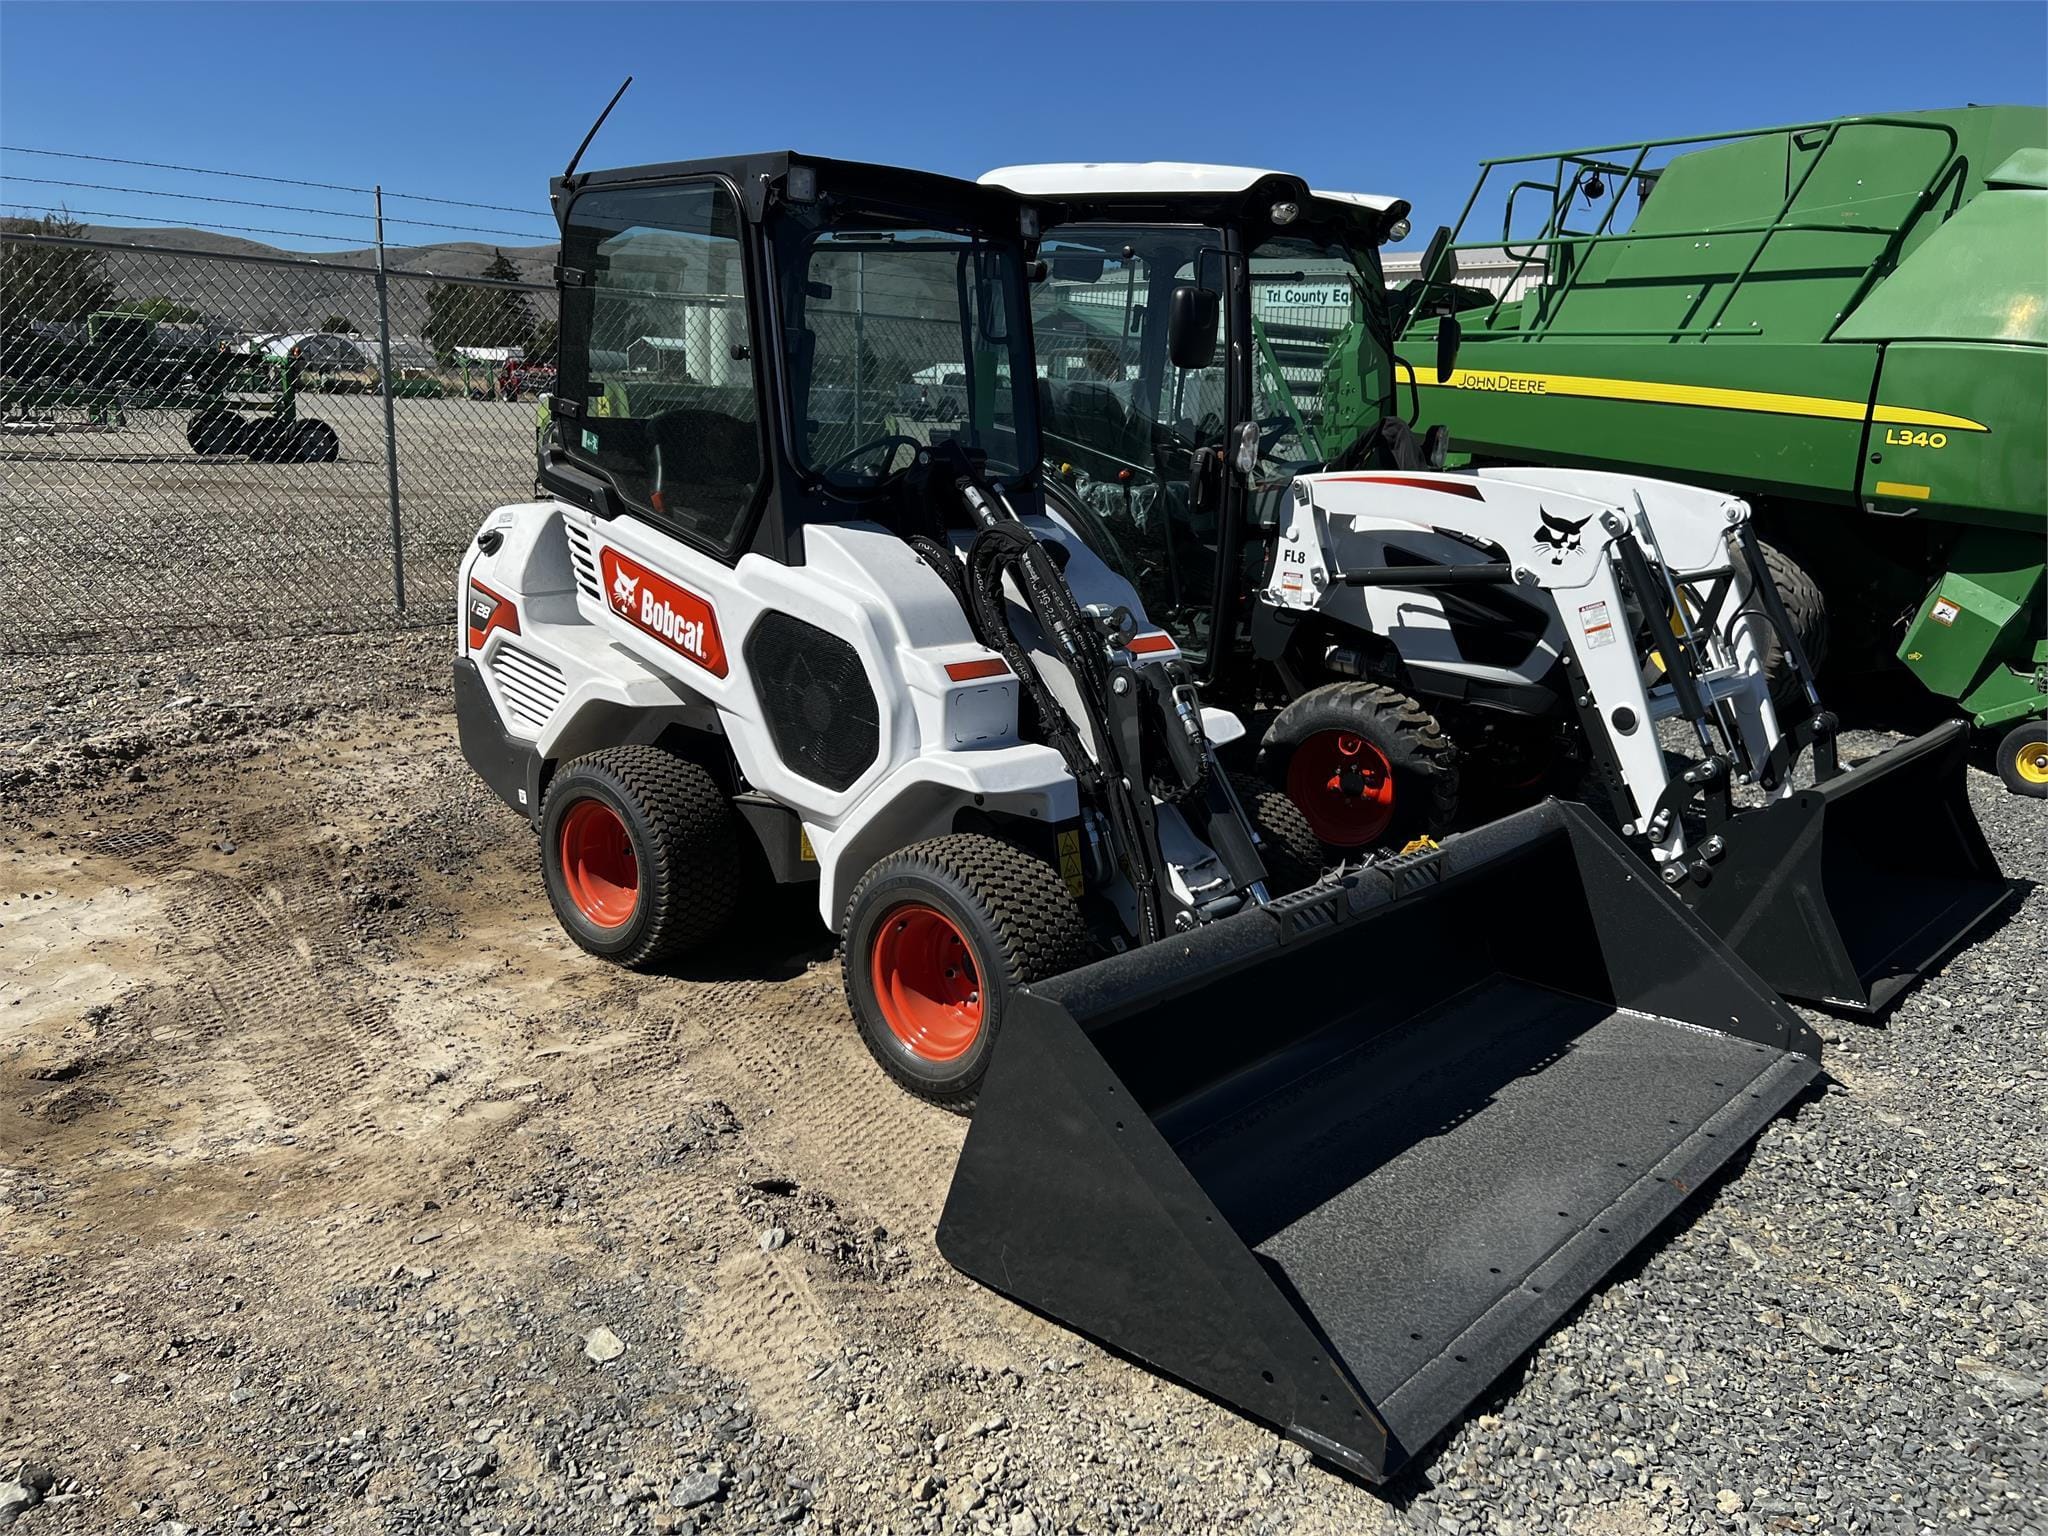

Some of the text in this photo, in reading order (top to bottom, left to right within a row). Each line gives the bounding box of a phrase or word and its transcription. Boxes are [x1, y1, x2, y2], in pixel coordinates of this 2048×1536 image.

[1267, 290, 1281, 302] Tri
[1285, 290, 1329, 305] County
[1459, 373, 1547, 392] JOHN DEERE
[1886, 428, 1947, 449] L340
[1283, 549, 1306, 564] FL8
[641, 587, 705, 658] Bobcat
